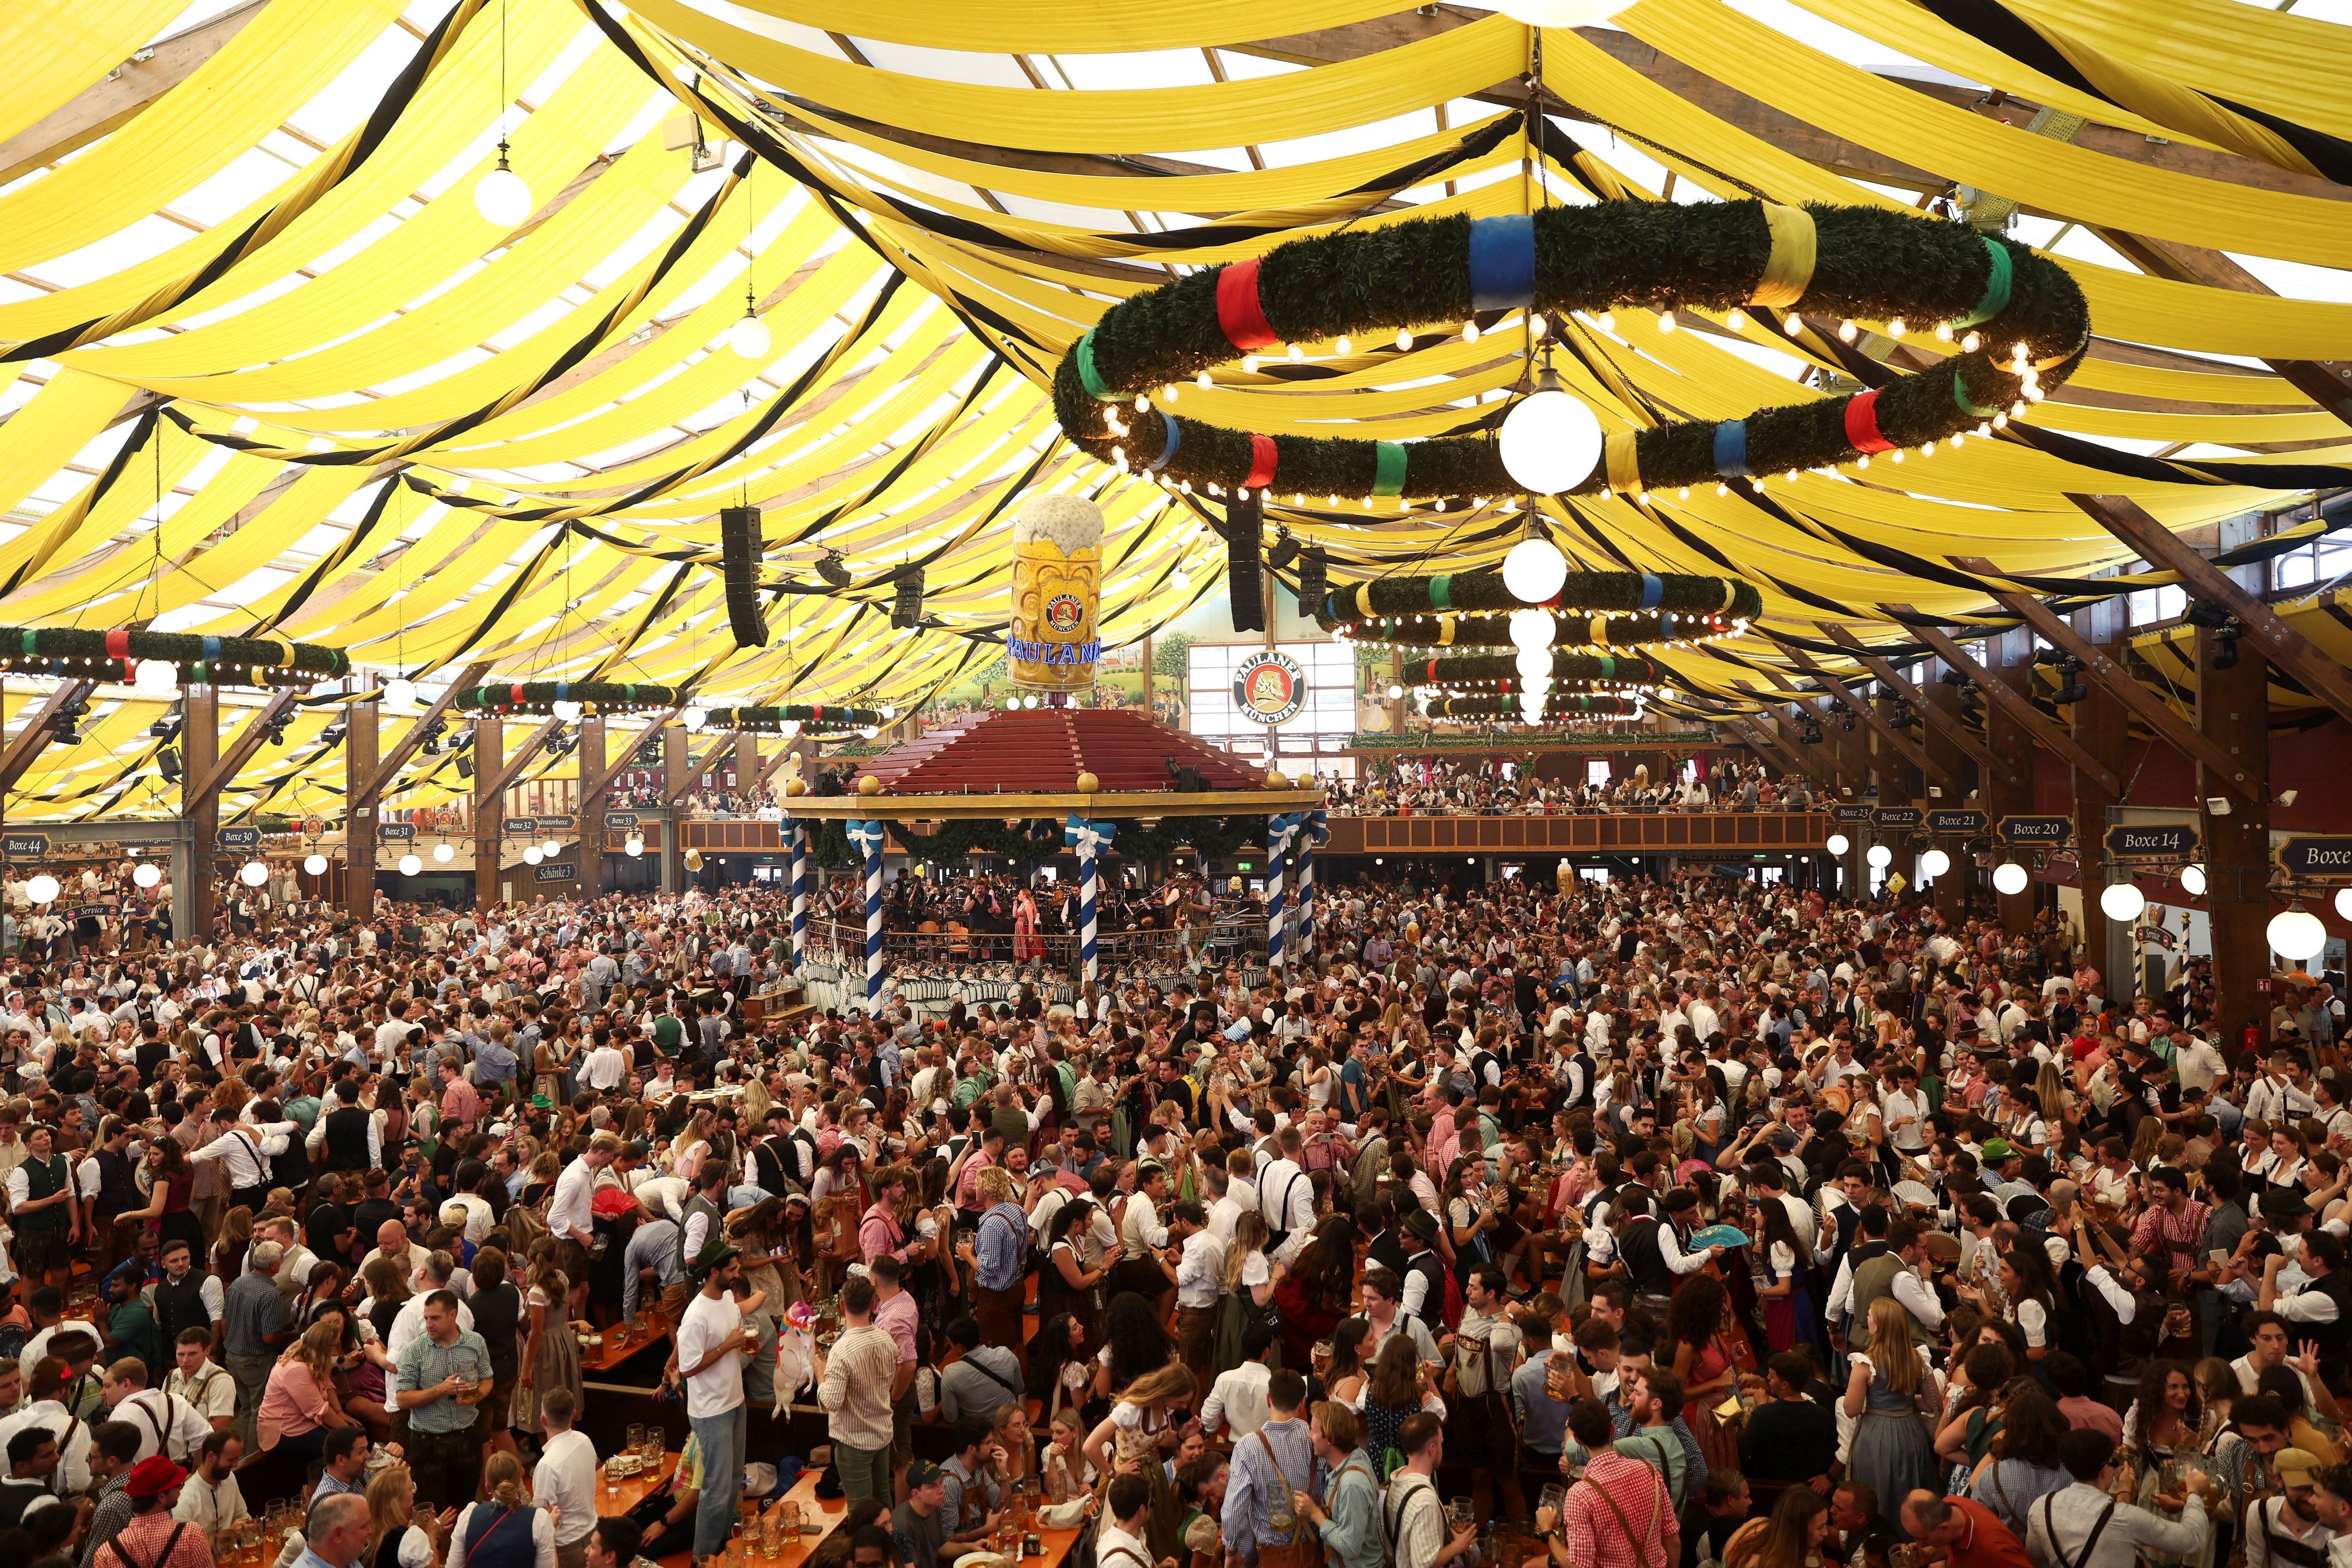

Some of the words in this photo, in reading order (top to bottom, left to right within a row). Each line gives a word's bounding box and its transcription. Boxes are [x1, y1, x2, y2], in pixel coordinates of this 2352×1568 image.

[1047, 595, 1082, 610] PAULANER
[1049, 620, 1079, 632] MÜNCHEN
[1235, 653, 1302, 684] PAULANER
[1240, 701, 1298, 723] MÜNCHEN
[1859, 809, 1868, 818] 23
[1882, 813, 1900, 821] Boxe
[1902, 813, 1913, 821] 22
[1939, 816, 1962, 825] Boxe
[1963, 816, 1975, 825] 21
[400, 827, 408, 837] 31
[2013, 824, 2040, 834] Boxe
[2043, 824, 2059, 834] 20
[225, 833, 242, 841] Boxe
[242, 832, 252, 843] 30
[2124, 834, 2158, 847] Boxe
[2161, 833, 2180, 849] 14
[9, 840, 27, 850] Boxe
[28, 840, 41, 852] 44
[2306, 847, 2351, 864] Boxe
[540, 868, 565, 880] Schänke
[566, 867, 570, 877] 3
[81, 907, 103, 915] Service
[2146, 928, 2160, 941] Service
